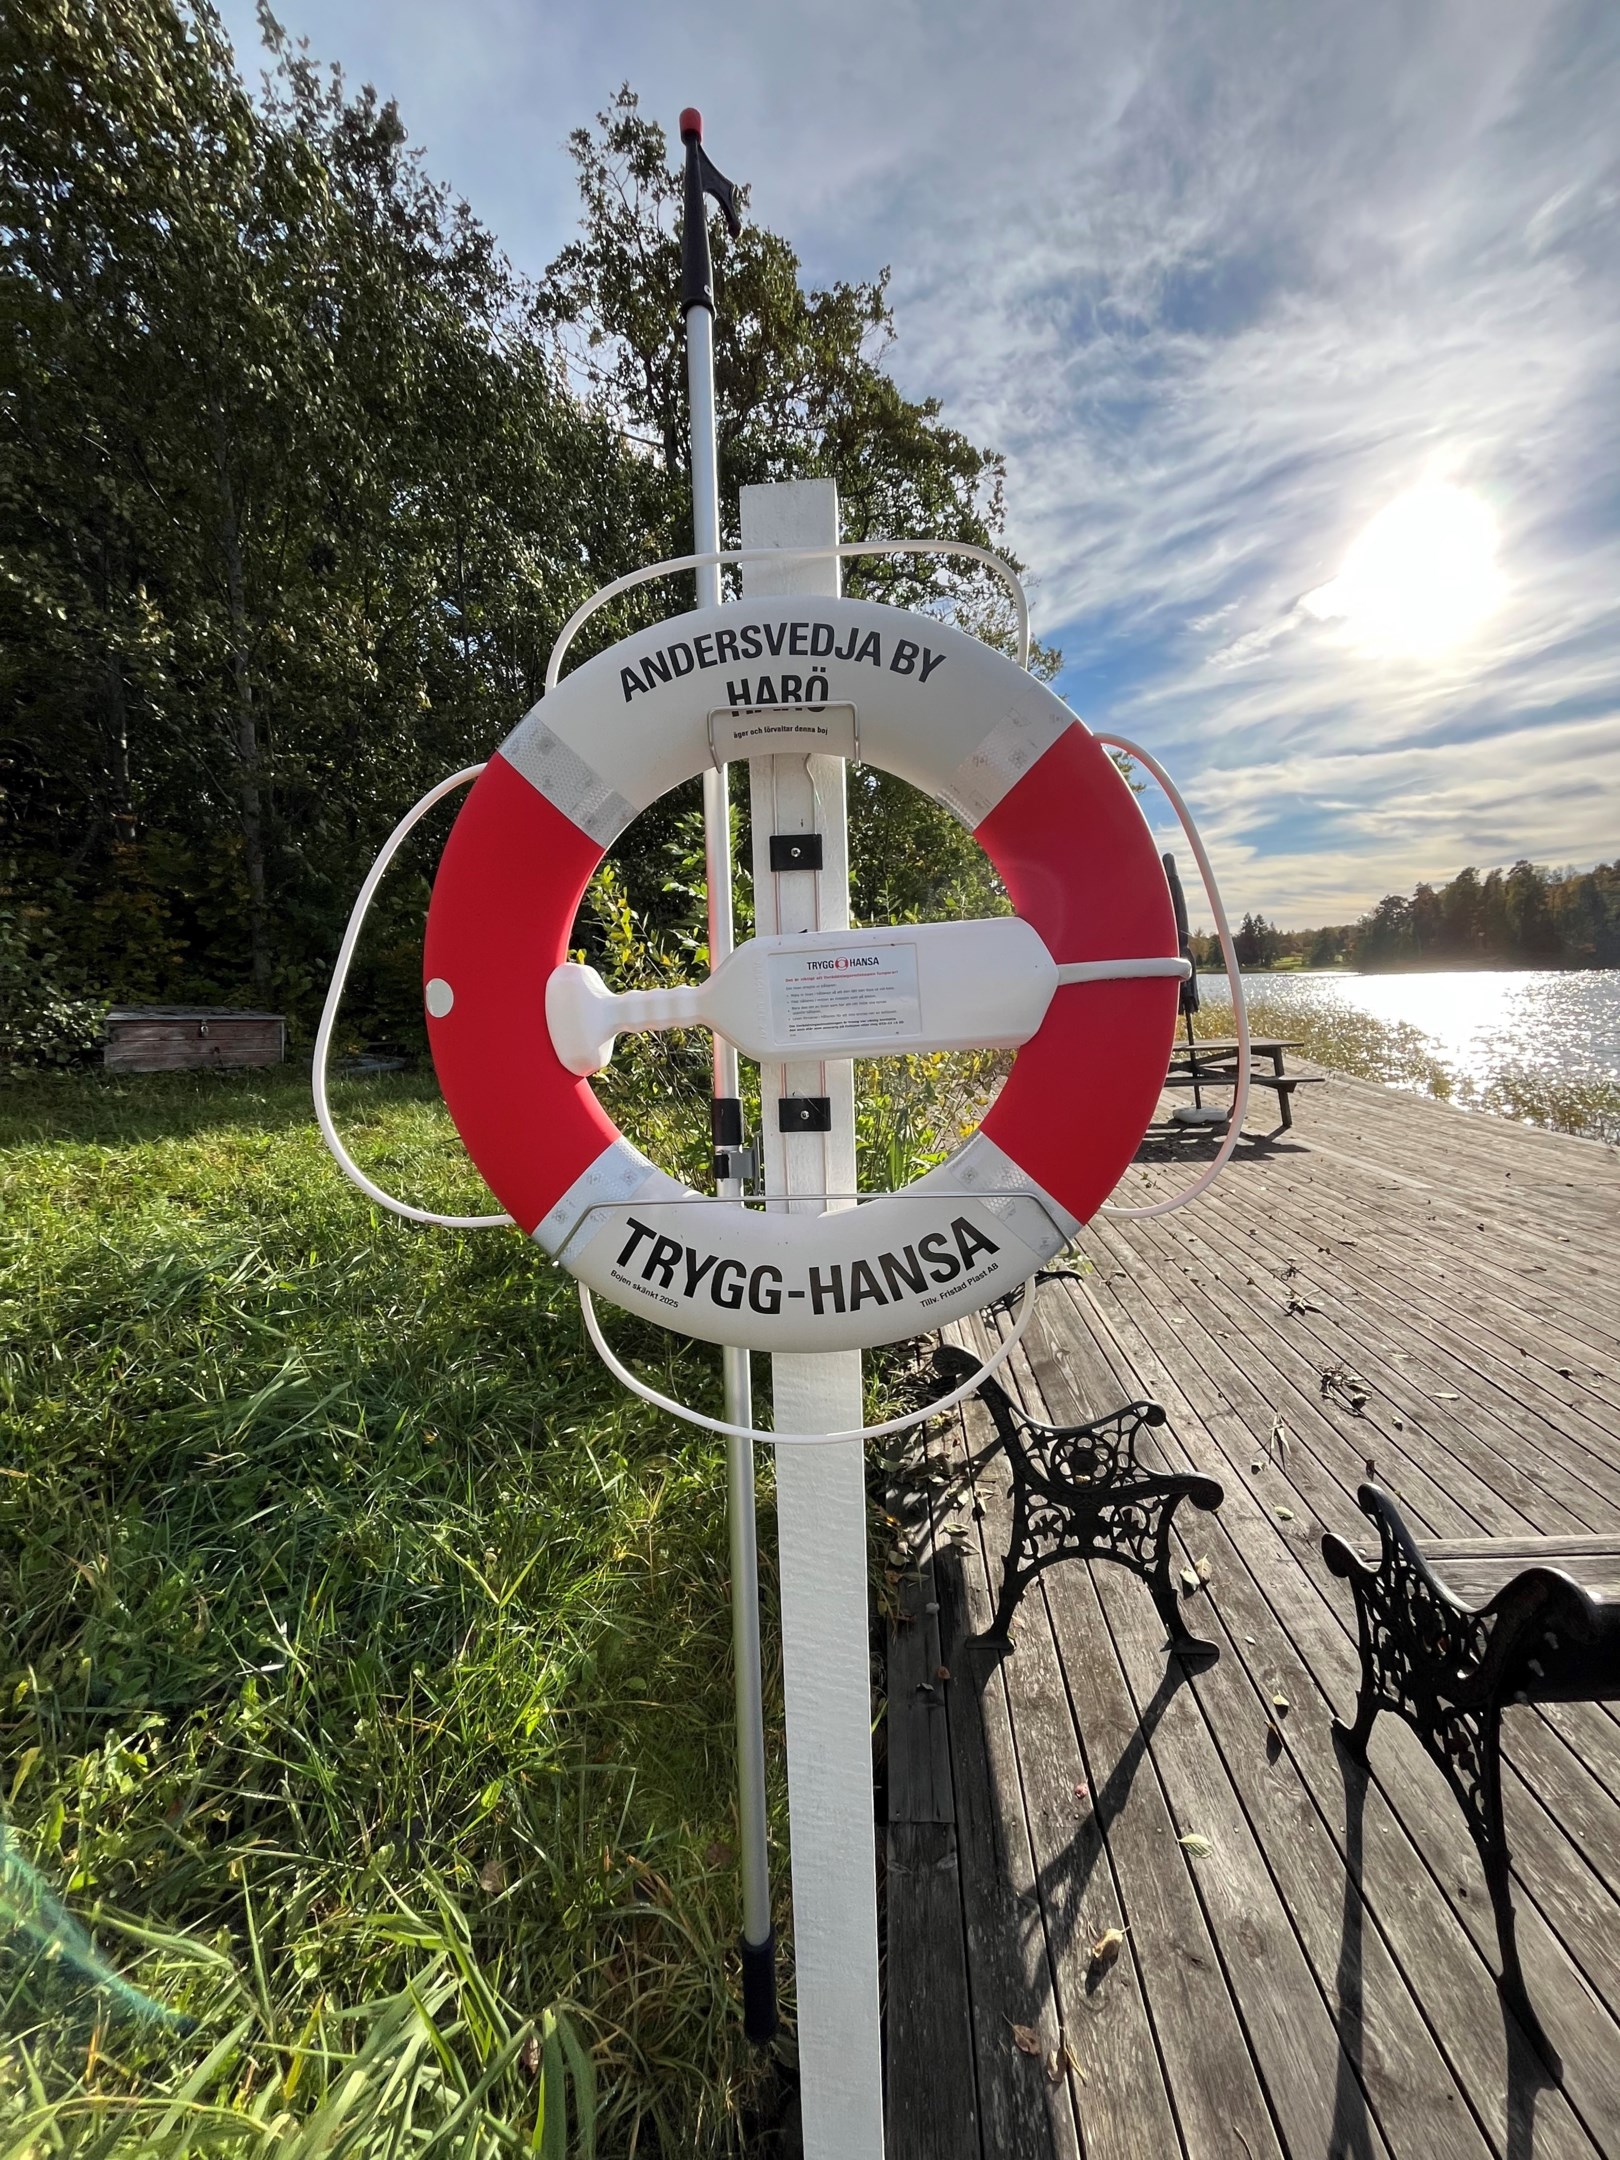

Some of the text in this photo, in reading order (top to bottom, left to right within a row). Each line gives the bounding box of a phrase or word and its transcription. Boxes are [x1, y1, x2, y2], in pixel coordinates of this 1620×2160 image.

[620, 622, 947, 703] ANDERSVEDJA BY
[726, 666, 829, 717] HARÖ
[733, 725, 828, 739] äger och förvaltar denna boj
[806, 956, 880, 970] TRYGG HANSA
[610, 1269, 679, 1308] Bojen skänkt 2025
[616, 1216, 1000, 1315] TRYGG-HANSA
[920, 1262, 999, 1308] Tillv. Fristad Plast AB
